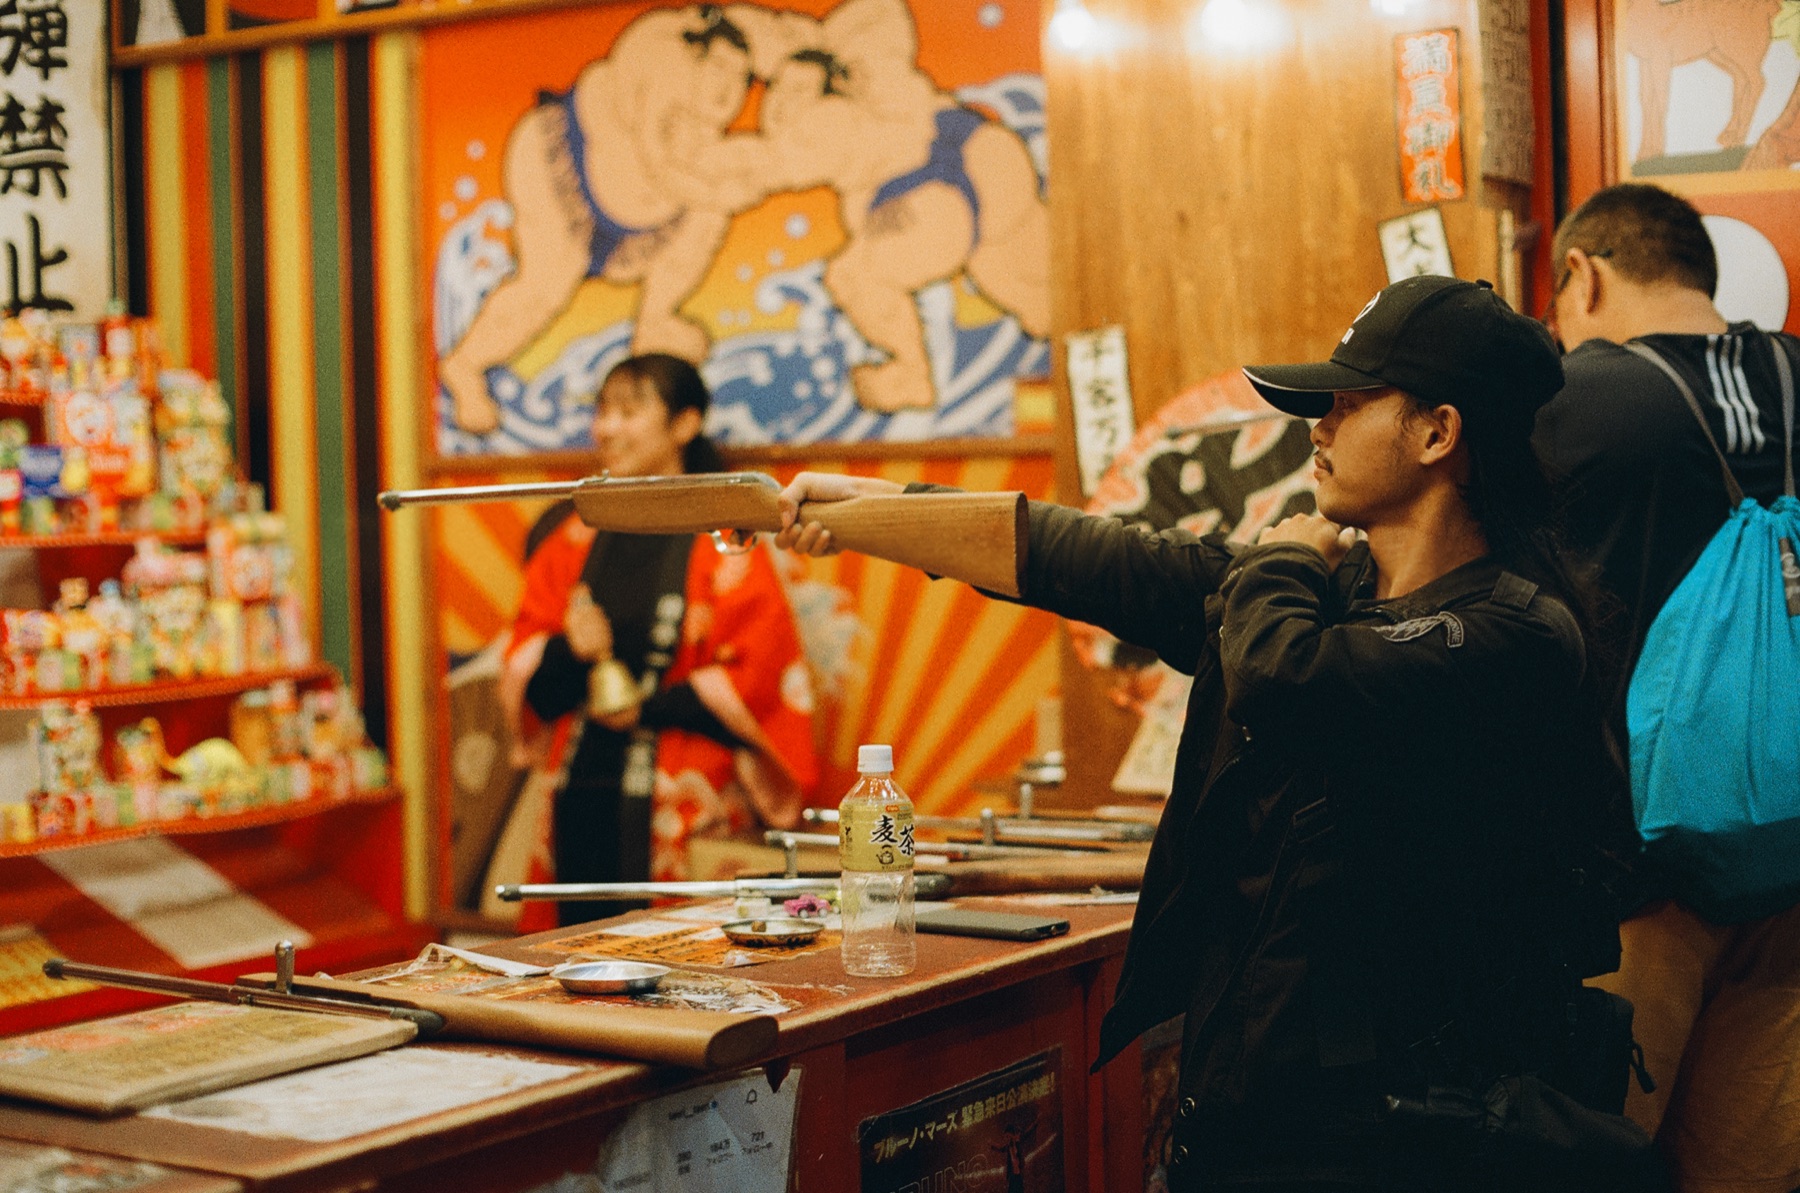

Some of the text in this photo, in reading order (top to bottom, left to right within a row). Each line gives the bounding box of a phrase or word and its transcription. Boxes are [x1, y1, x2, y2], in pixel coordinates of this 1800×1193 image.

[870, 814, 915, 856] 麦茶
[873, 1110, 958, 1164] ブルーノ・マーズ
